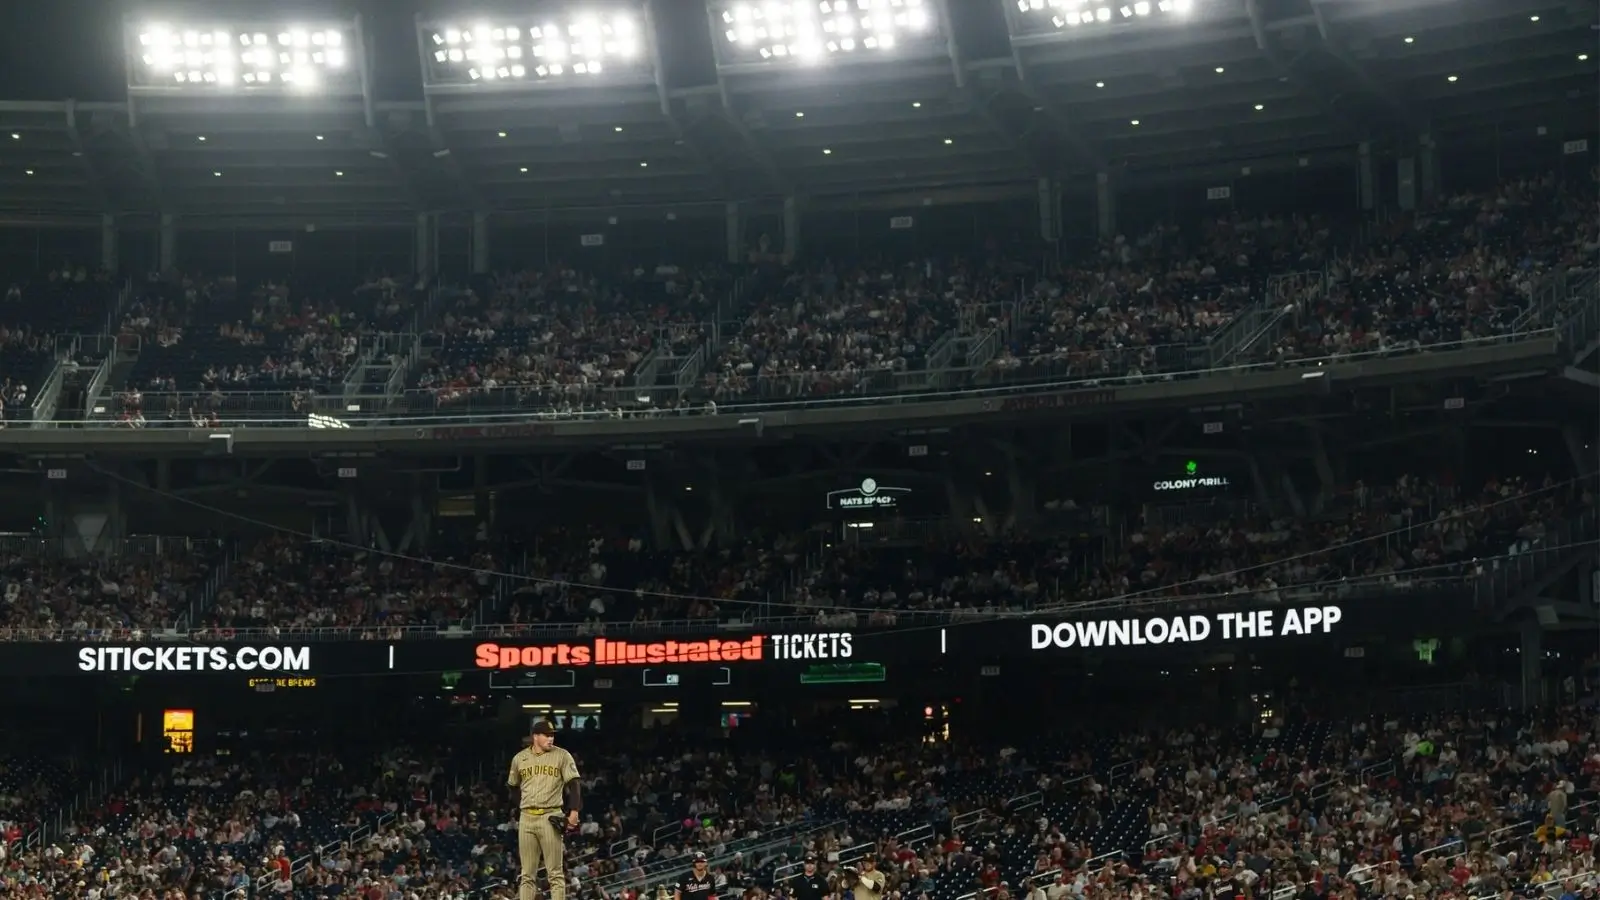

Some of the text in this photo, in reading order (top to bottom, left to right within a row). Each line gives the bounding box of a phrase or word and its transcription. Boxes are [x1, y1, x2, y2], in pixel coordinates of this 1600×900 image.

[1153, 478, 1197, 490] COLONY
[840, 497, 863, 506] NATS
[1032, 606, 1341, 649] DOWNLOAD THE APP
[78, 646, 310, 671] SITICKETS.COM
[476, 633, 852, 669] Sports Illustrated TICKETS
[534, 765, 559, 778] DIEGO
